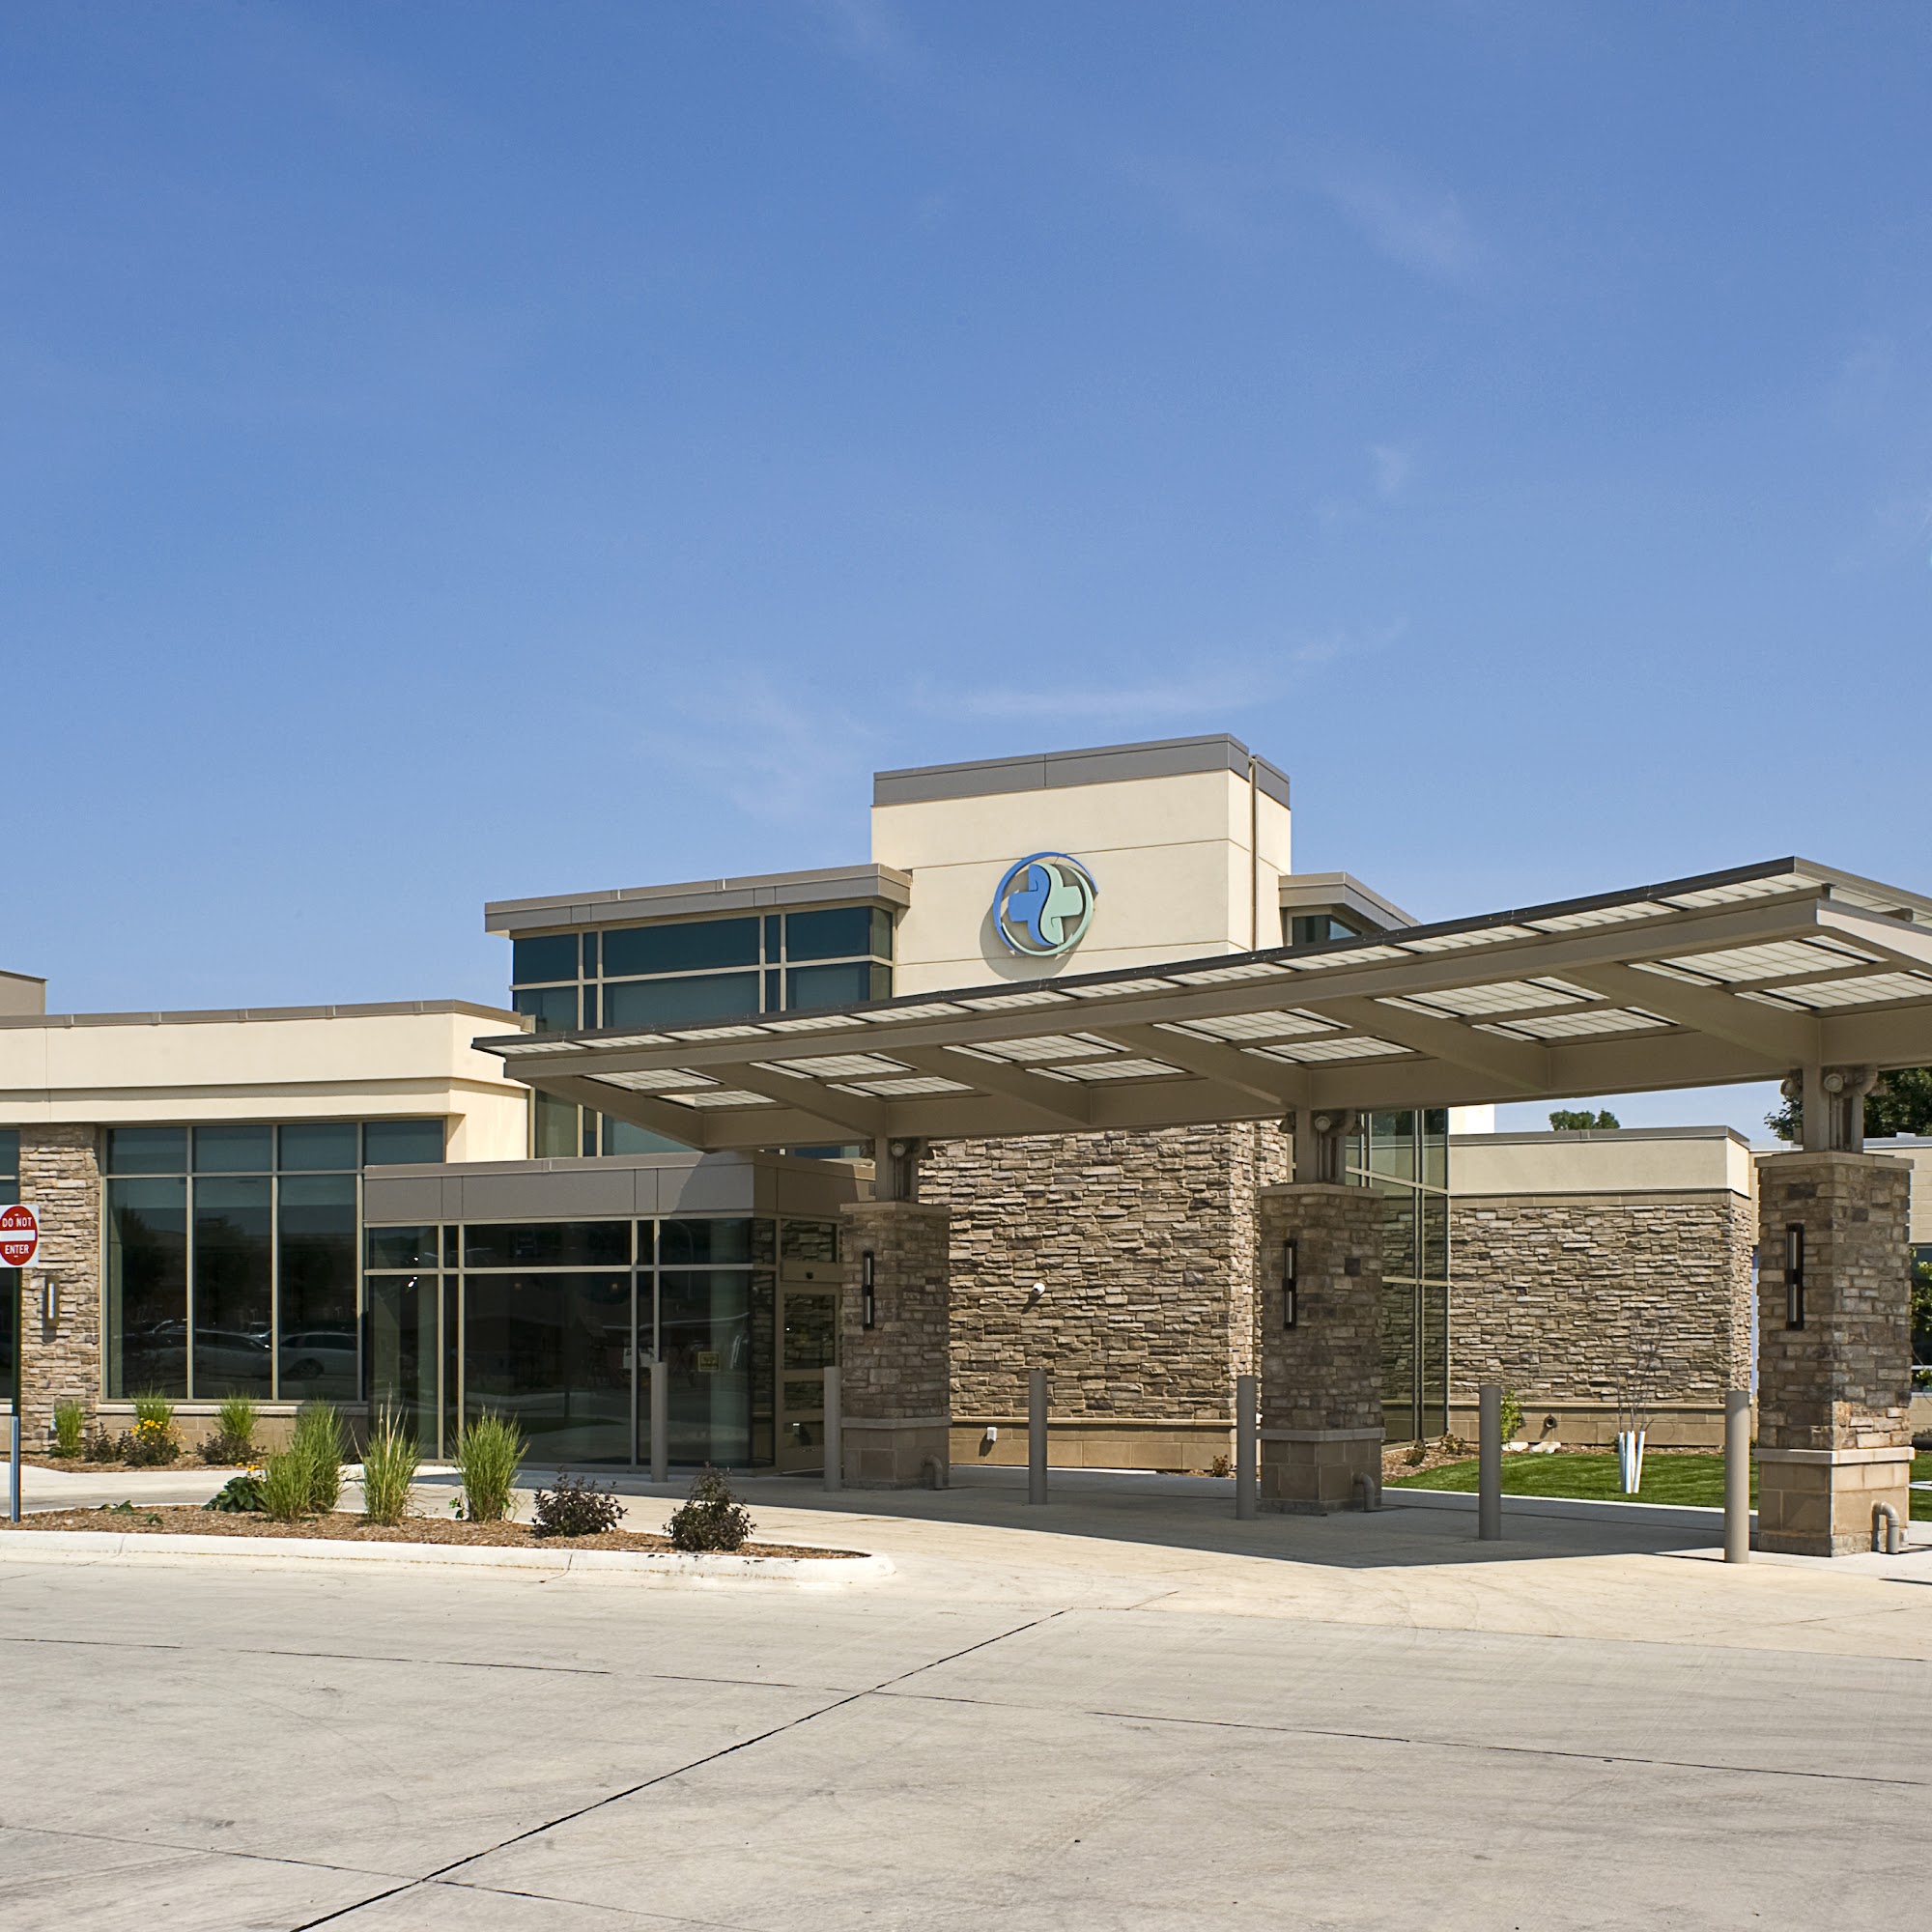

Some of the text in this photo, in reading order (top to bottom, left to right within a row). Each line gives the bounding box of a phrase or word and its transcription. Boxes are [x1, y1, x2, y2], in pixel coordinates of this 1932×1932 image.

[2, 1216, 32, 1228] DO NOT
[5, 1244, 29, 1255] ENTER
